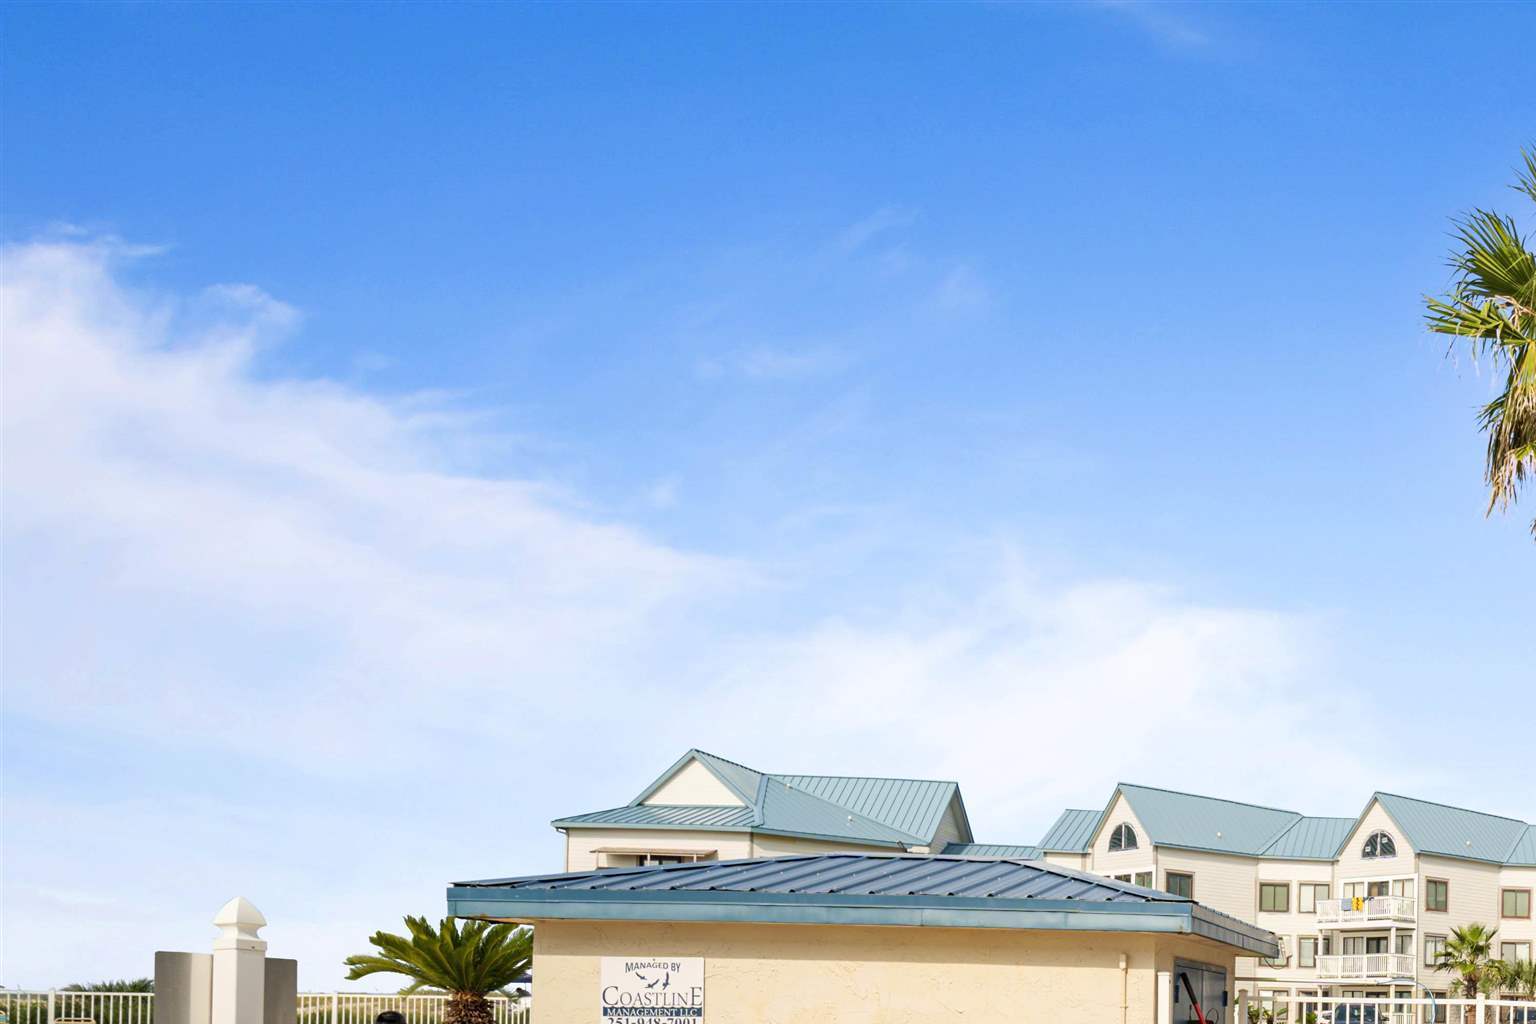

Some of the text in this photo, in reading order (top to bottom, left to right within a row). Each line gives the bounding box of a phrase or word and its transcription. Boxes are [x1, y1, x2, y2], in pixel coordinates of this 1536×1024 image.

[625, 962, 681, 973] MANAGED BY
[602, 986, 703, 1006] COASTLINE
[607, 1008, 698, 1017] MANAGEMENT LLC
